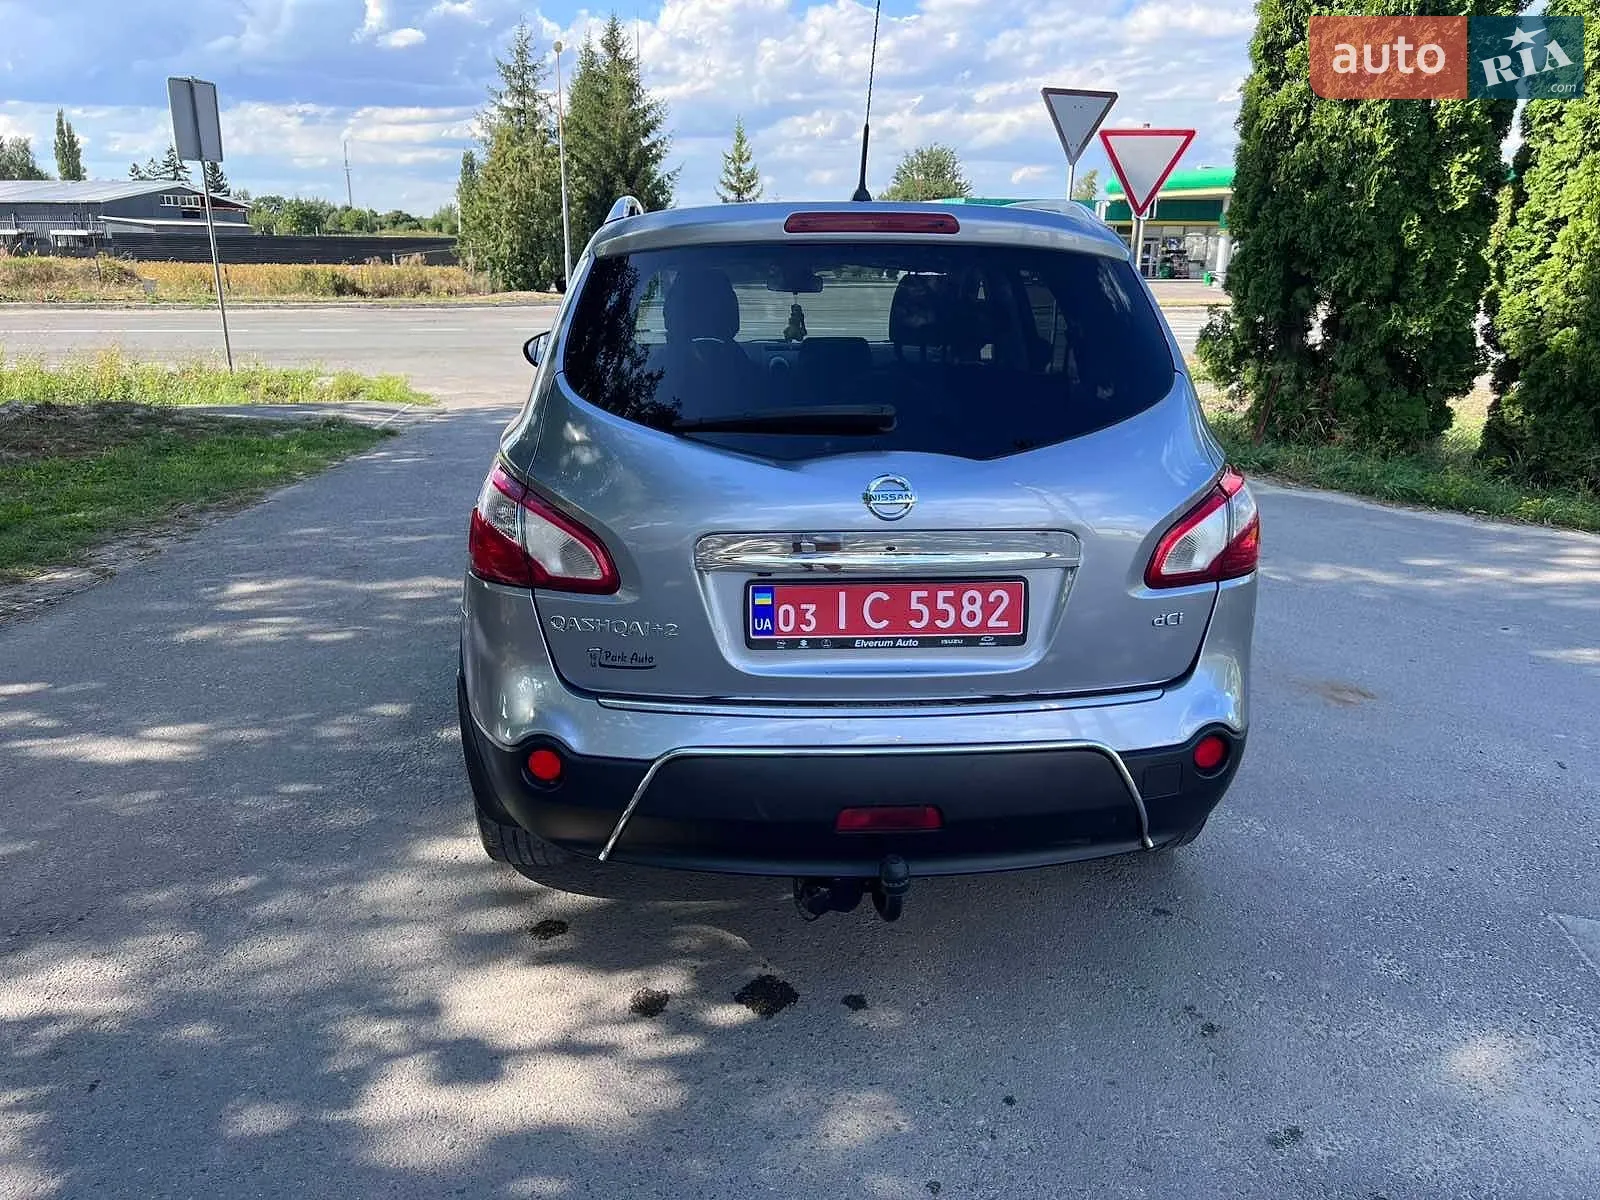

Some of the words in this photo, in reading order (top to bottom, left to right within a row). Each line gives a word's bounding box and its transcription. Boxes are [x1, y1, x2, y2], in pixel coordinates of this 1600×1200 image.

[868, 493, 913, 501] NISSAN
[778, 603, 816, 632] 03
[908, 590, 1010, 628] 5582
[754, 618, 772, 631] UA
[854, 639, 894, 648] Elverum
[895, 638, 919, 647] Auto
[604, 650, 627, 662] Park
[629, 651, 654, 664] Auto
